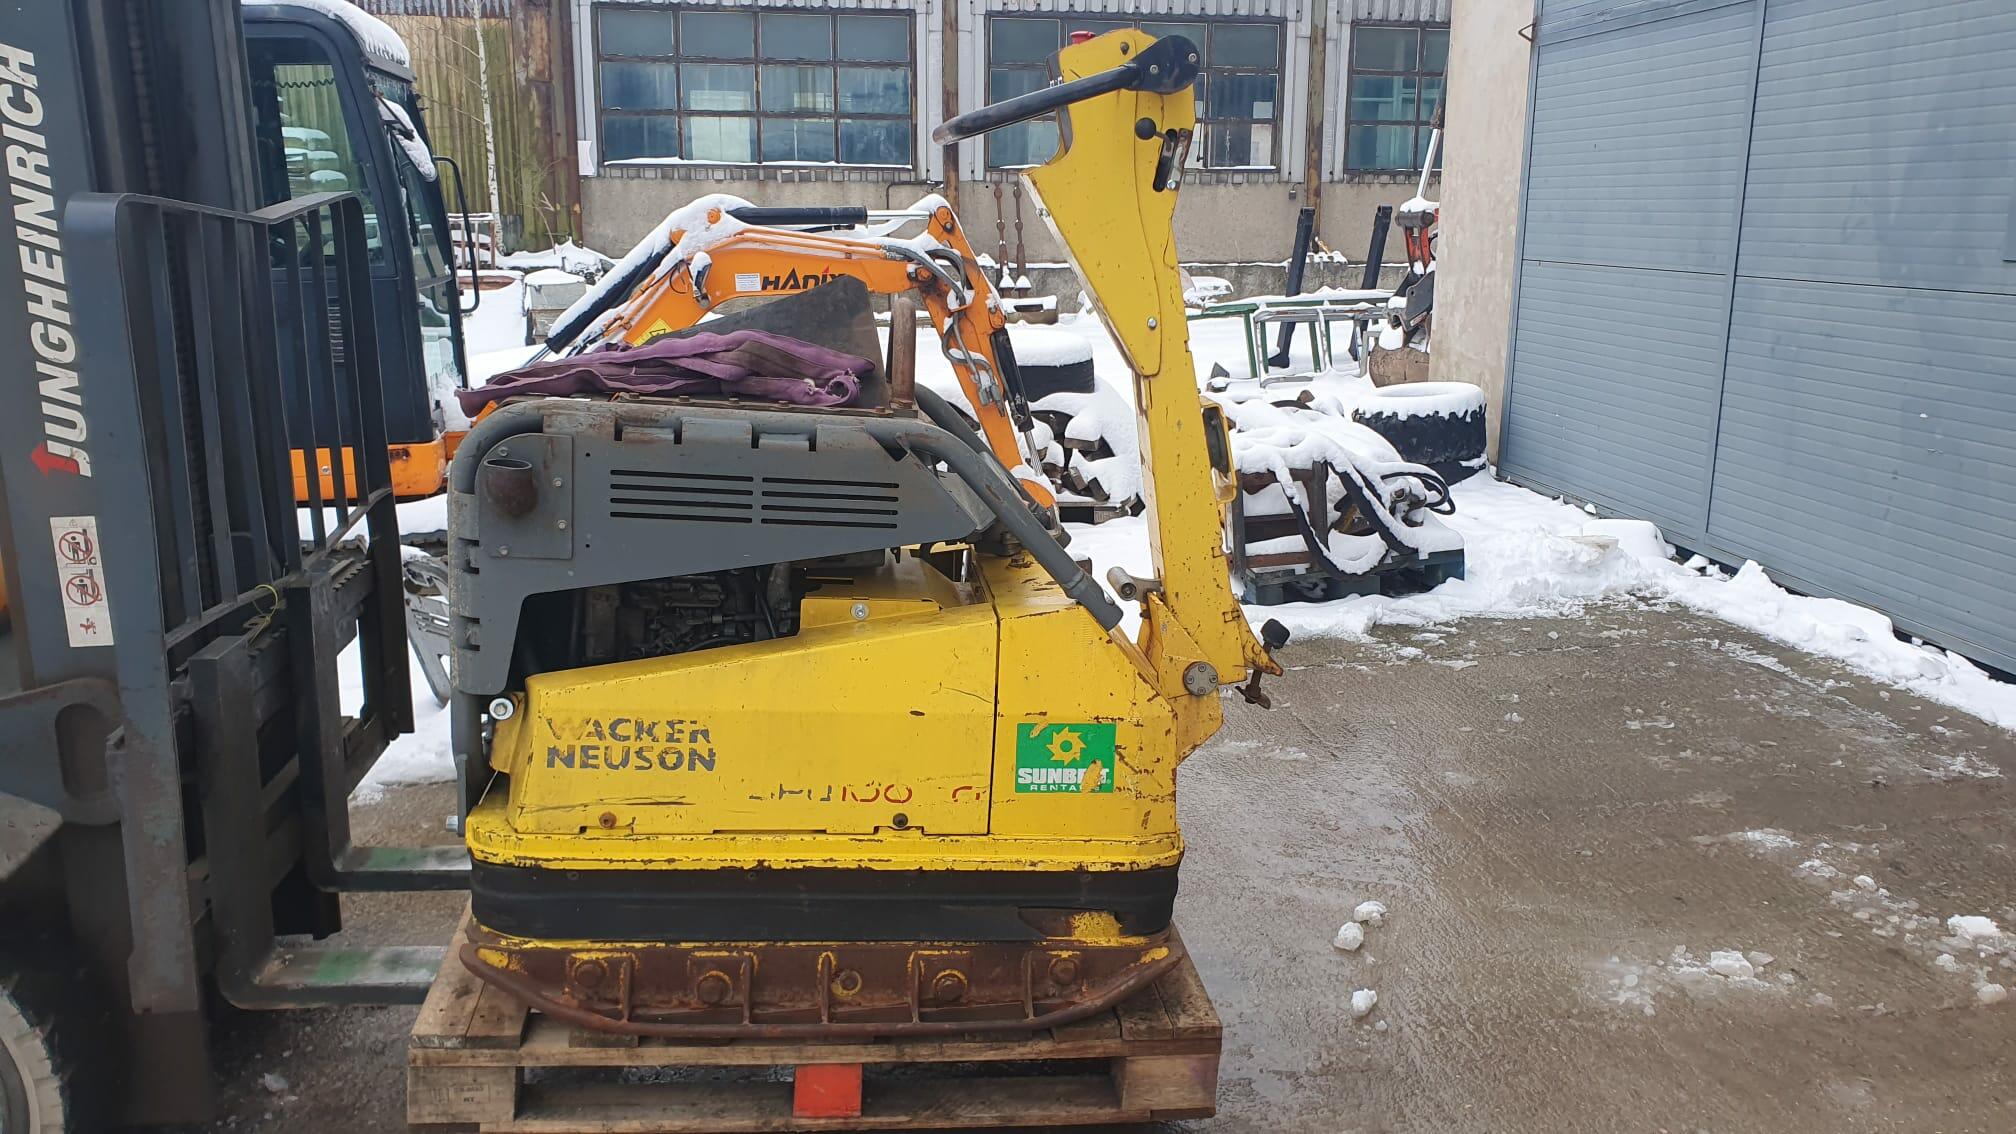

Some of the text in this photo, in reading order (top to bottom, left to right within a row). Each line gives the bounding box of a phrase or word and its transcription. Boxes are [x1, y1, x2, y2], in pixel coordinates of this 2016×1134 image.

[0, 43, 92, 478] JUNGHEINRICH
[546, 744, 716, 772] NEUSON
[1017, 767, 1110, 784] SUNBT
[1030, 784, 1100, 792] RENTA
